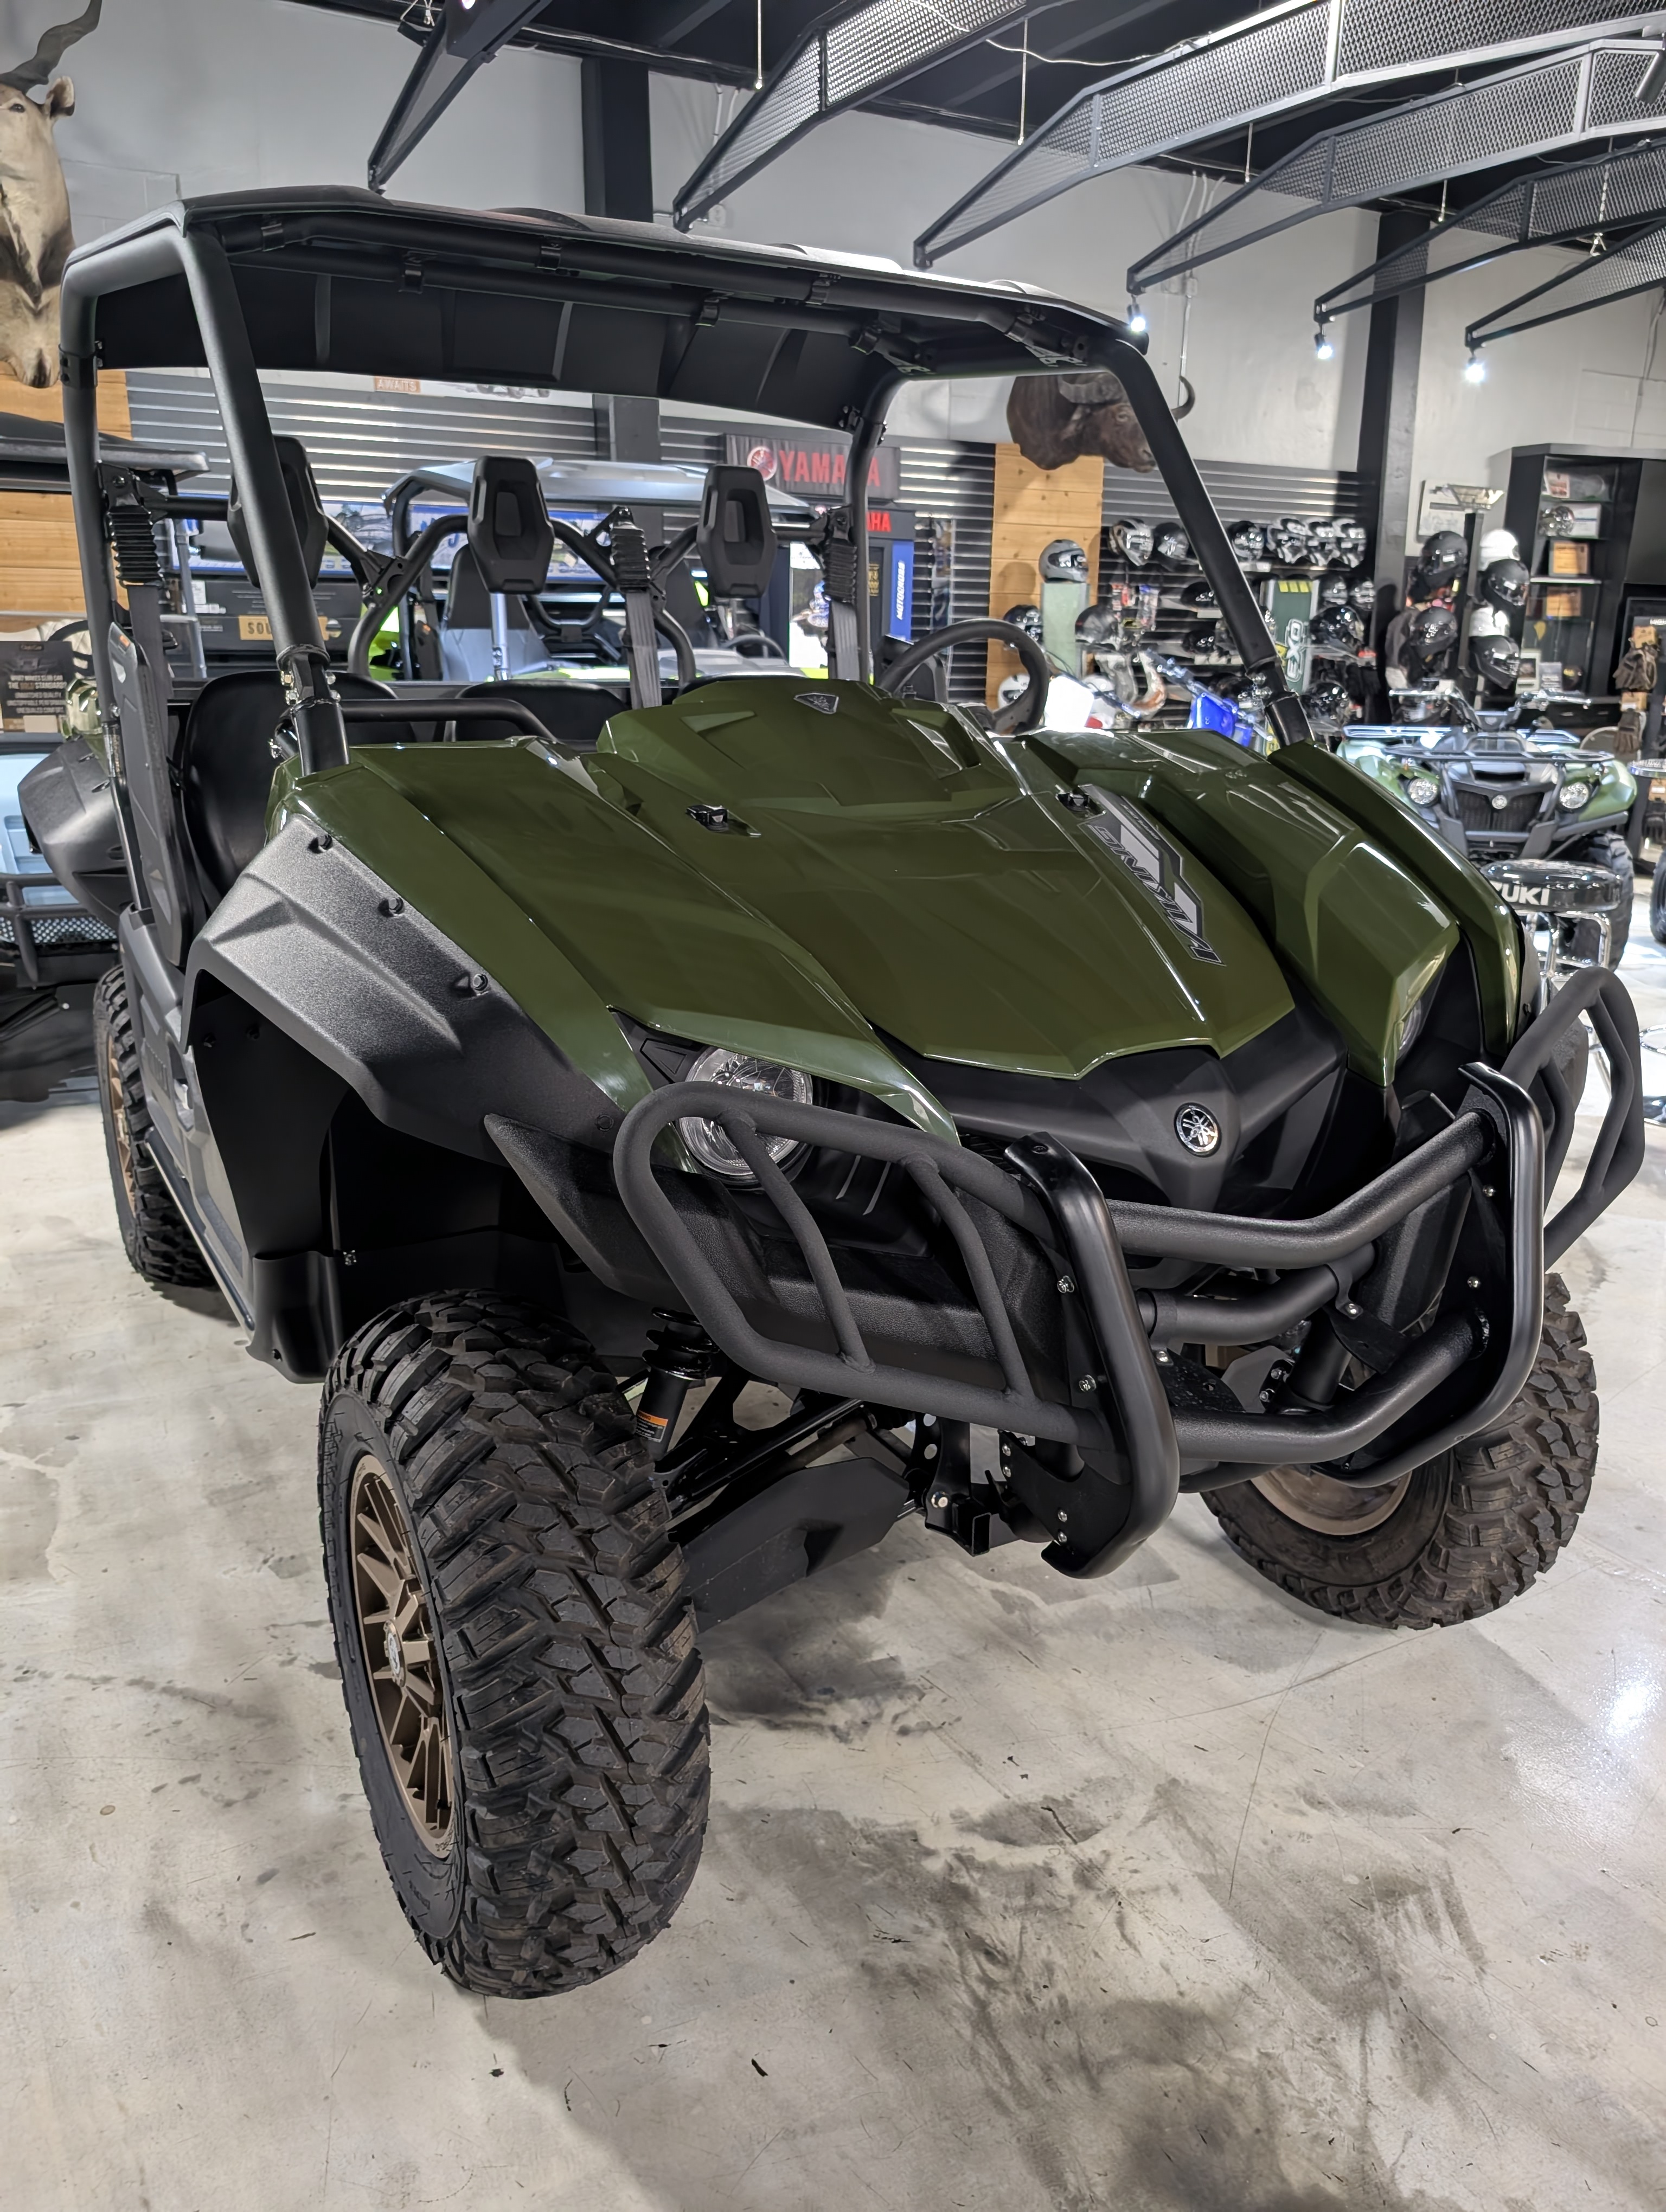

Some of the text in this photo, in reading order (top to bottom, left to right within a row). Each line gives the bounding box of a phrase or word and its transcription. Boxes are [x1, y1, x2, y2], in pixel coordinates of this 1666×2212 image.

[376, 379, 417, 391] AWAITS
[779, 451, 881, 486] YAMAA
[895, 561, 906, 620] MOTOCROSS
